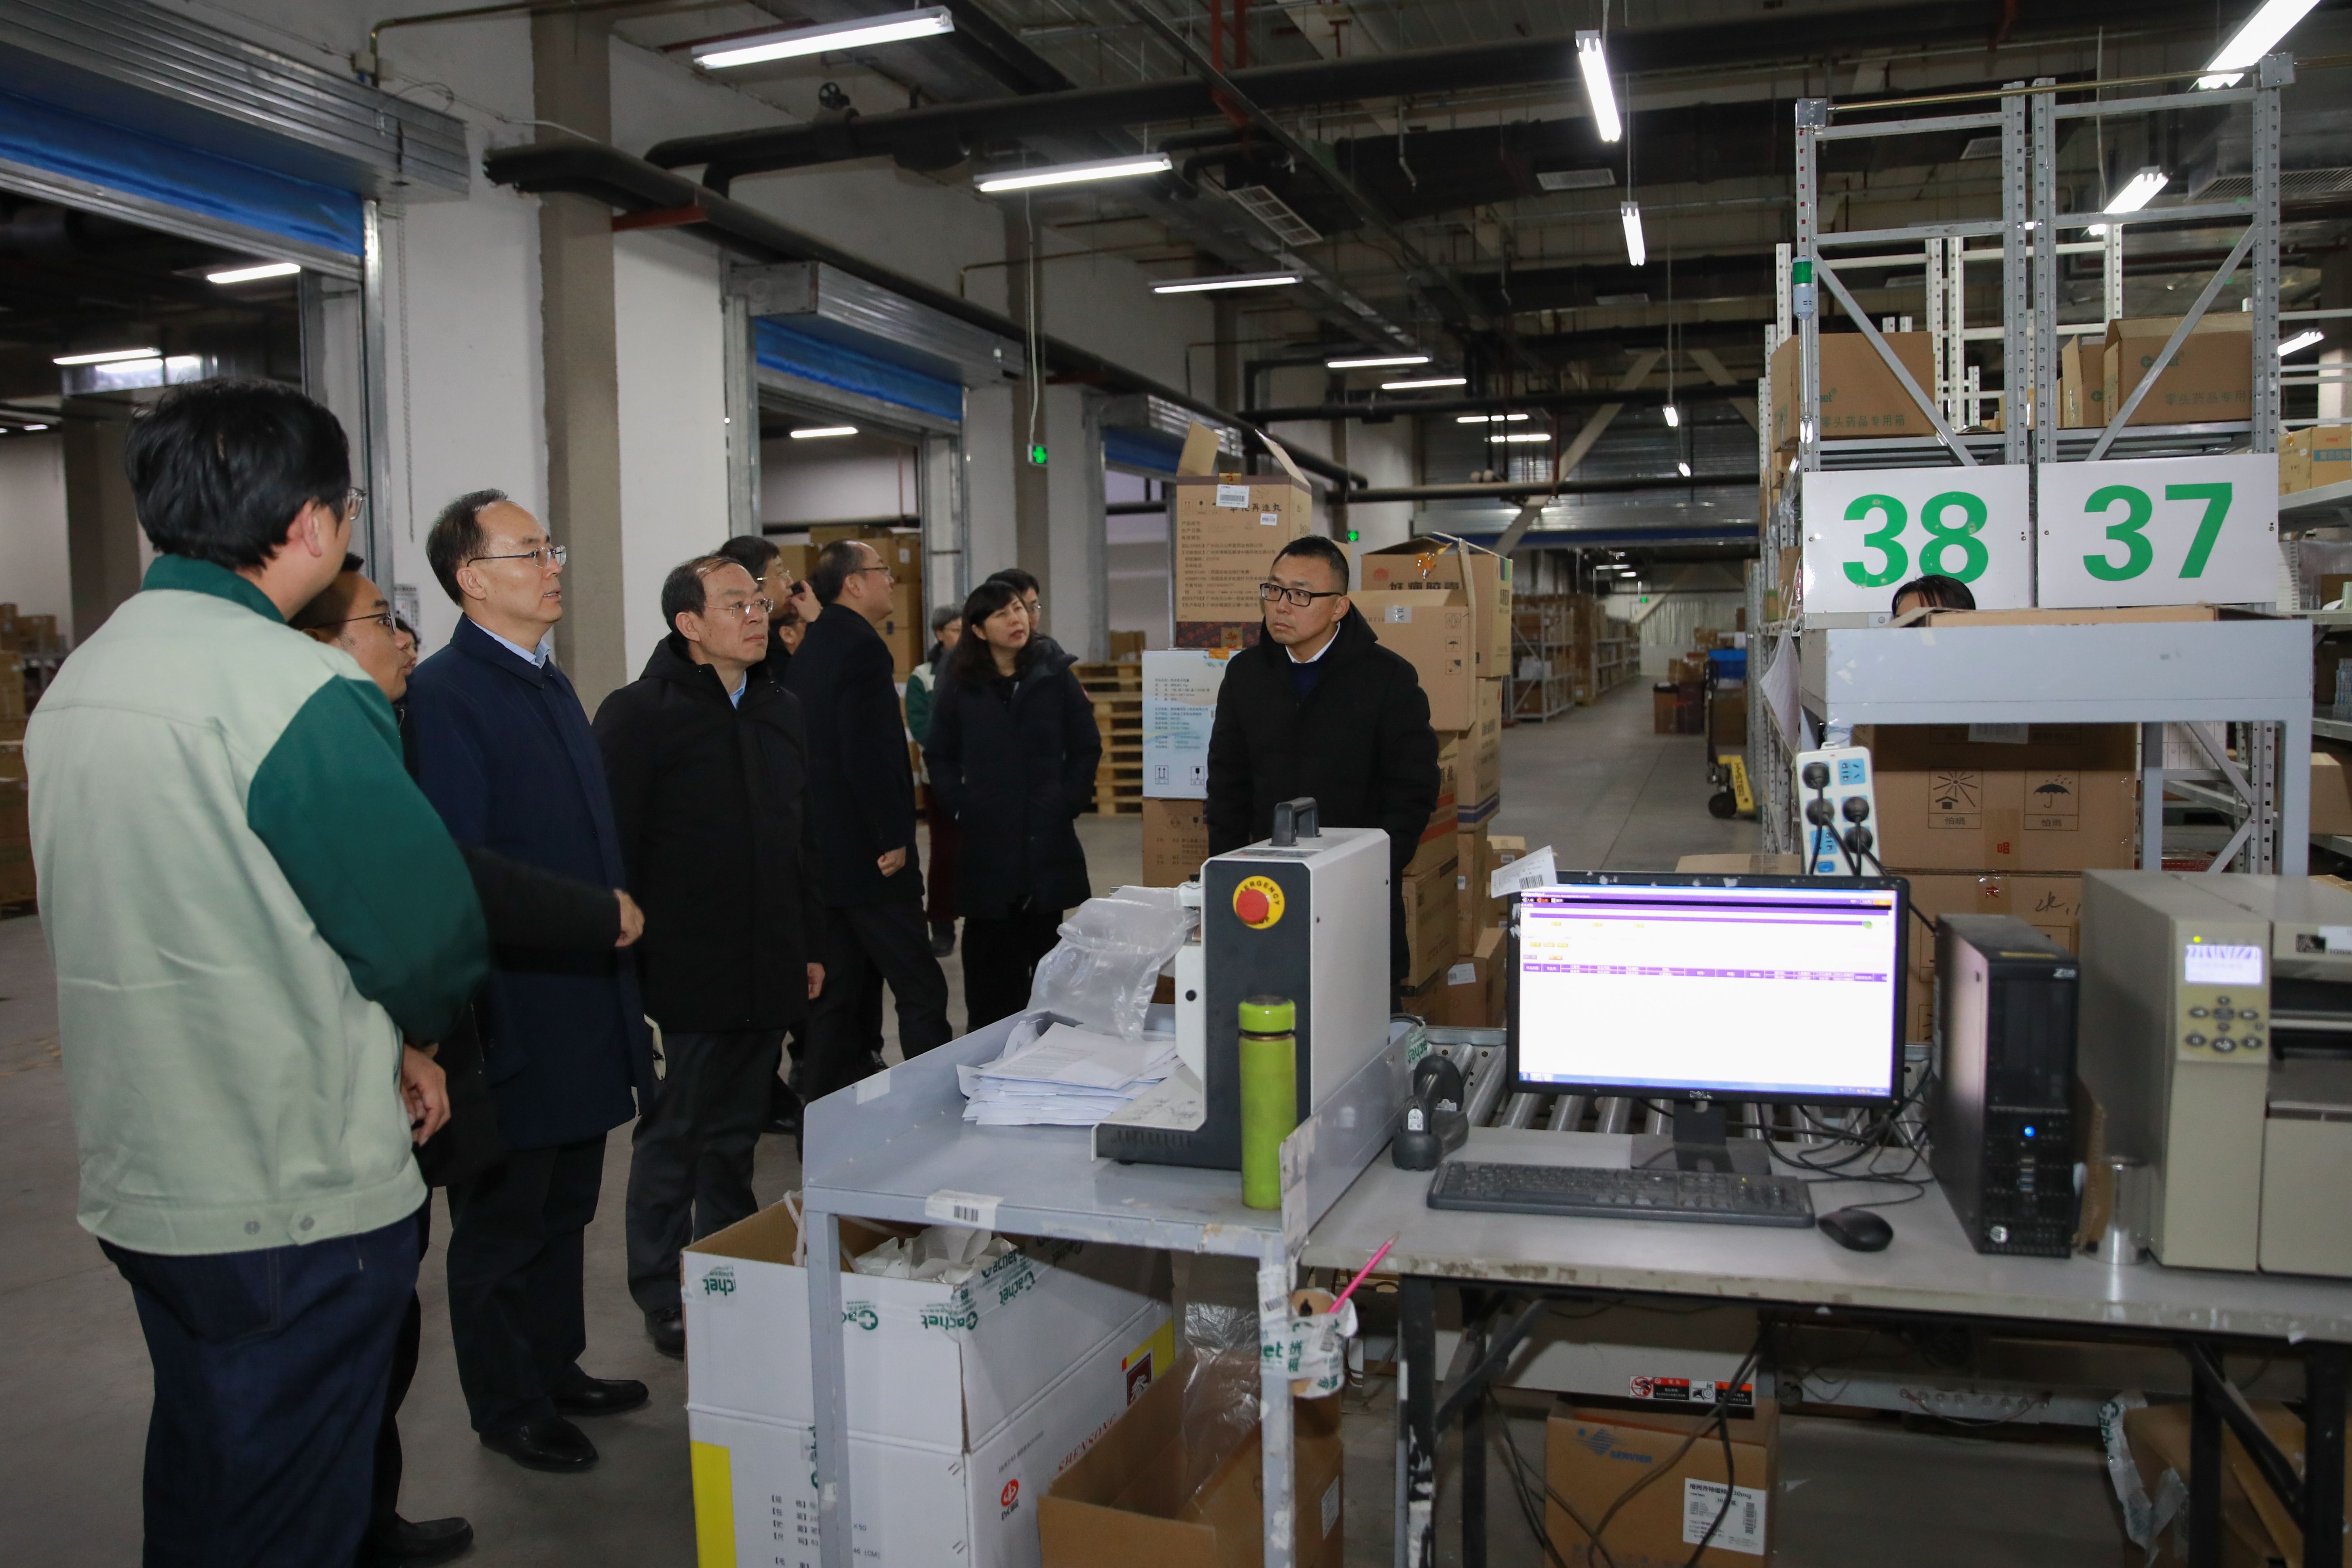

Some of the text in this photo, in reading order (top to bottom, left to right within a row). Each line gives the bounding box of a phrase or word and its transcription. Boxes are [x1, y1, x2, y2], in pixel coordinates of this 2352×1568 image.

[2165, 391, 2246, 406] 零头药品专用
[1842, 491, 1989, 587] 38
[2083, 482, 2232, 581] 37
[1945, 817, 1965, 826] 怕晒
[2041, 819, 2061, 827] 怕雨
[1239, 880, 1280, 905] ERGENCY
[703, 1278, 736, 1296] chet
[1689, 1483, 1751, 1499] 格列齐特缓释 30mg
